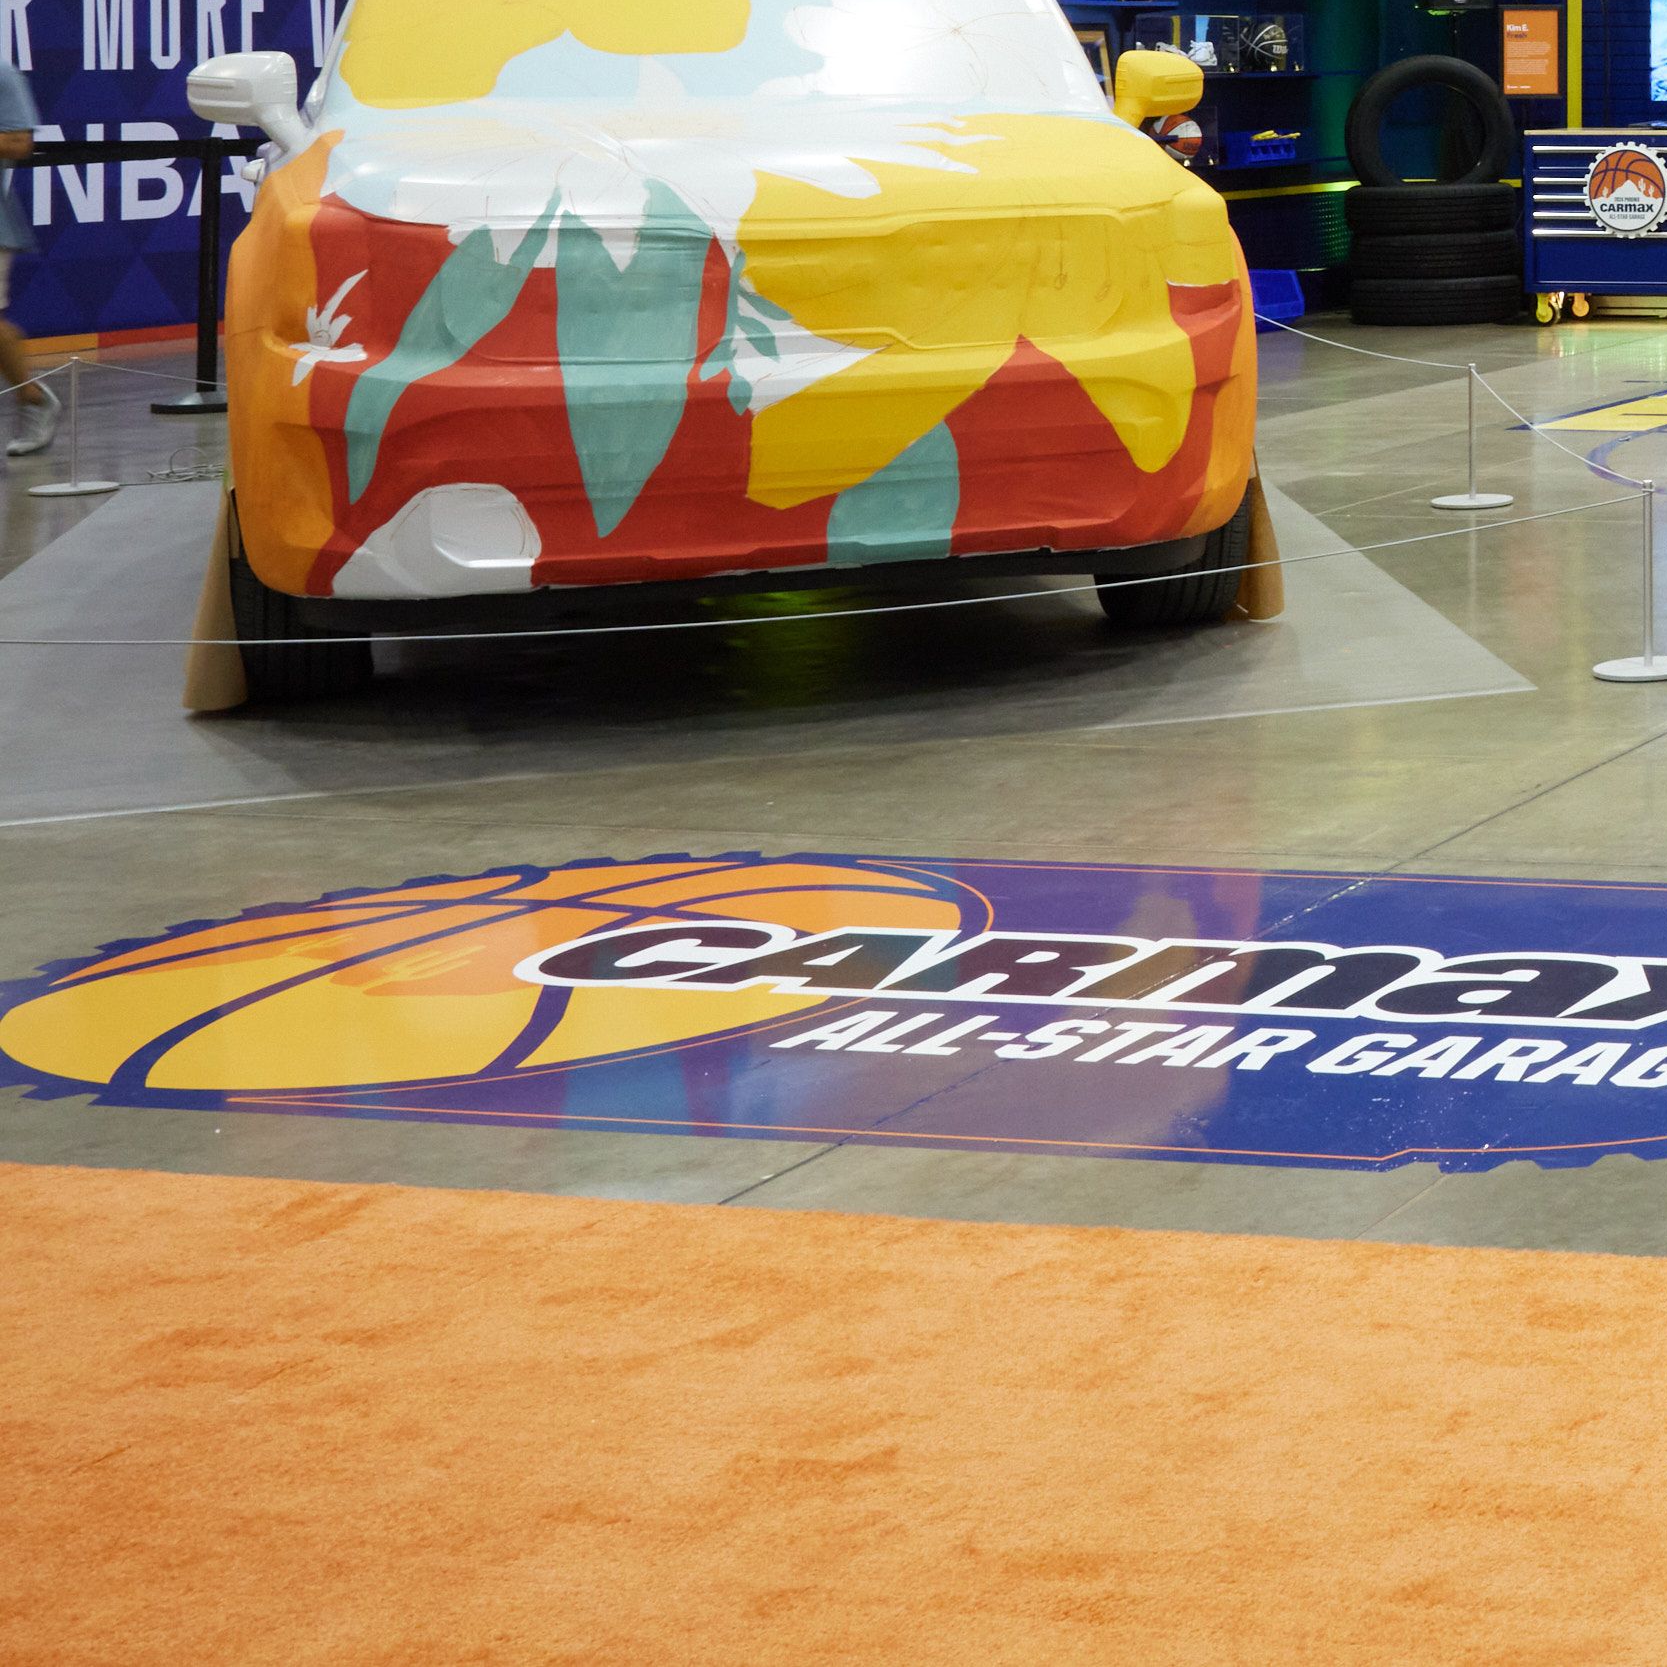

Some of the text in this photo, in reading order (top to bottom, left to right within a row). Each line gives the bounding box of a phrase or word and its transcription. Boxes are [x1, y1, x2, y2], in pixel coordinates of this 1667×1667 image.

[4, 121, 255, 226] NBA
[1600, 203, 1654, 213] CARmax
[771, 1009, 1318, 1072] ALL-STAR
